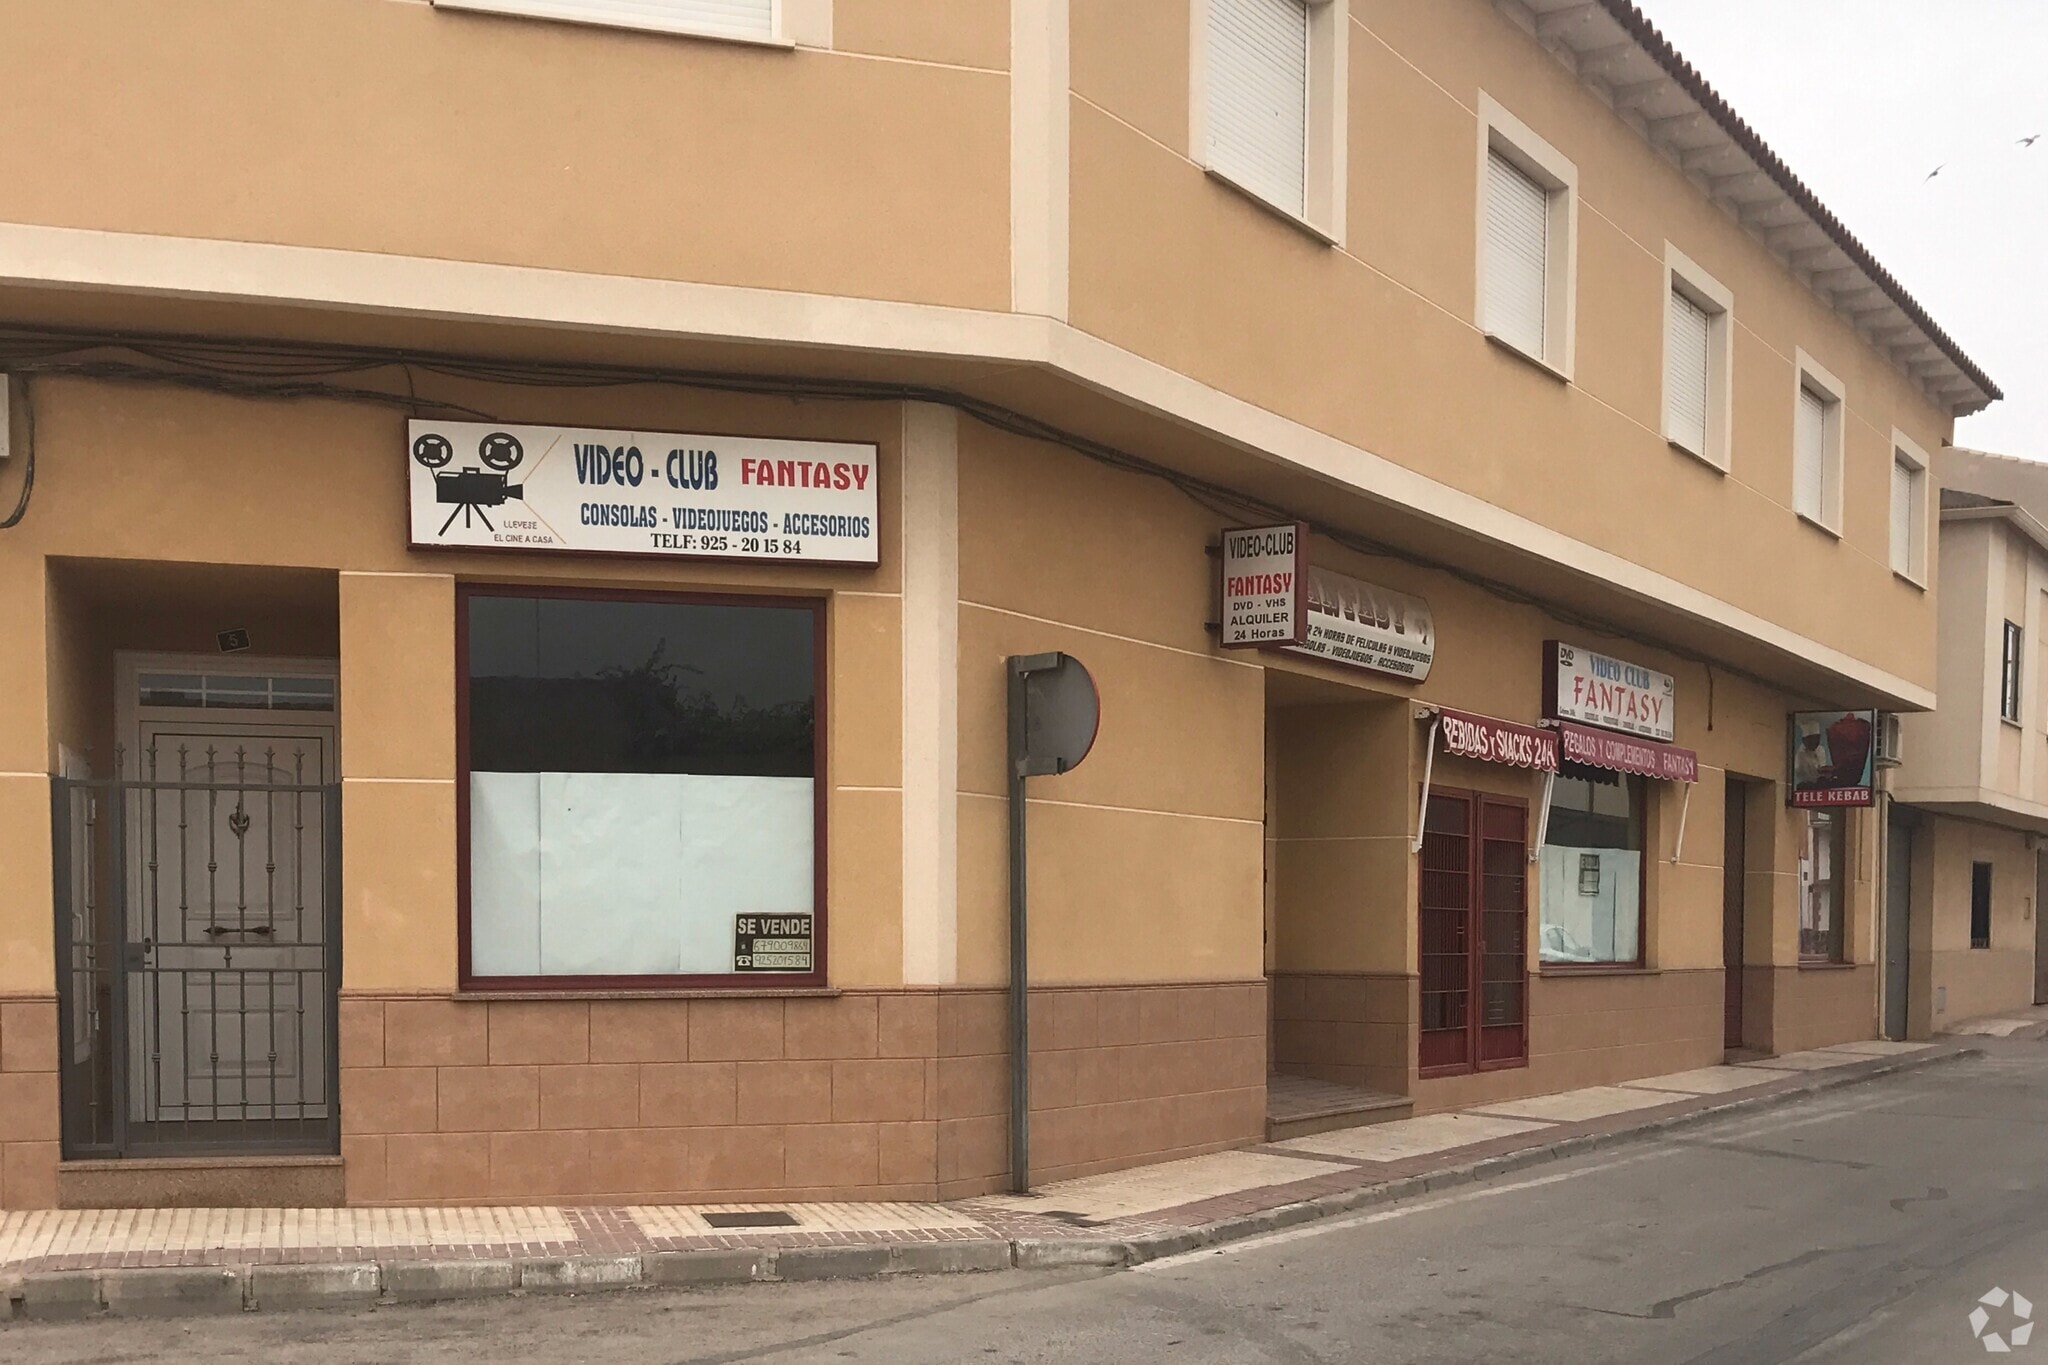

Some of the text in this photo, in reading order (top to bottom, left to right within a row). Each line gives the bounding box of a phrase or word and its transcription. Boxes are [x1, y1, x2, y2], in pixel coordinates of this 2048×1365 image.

[573, 443, 644, 487] VIDEO
[666, 449, 718, 490] CLUB
[741, 458, 869, 490] FANTASY
[580, 502, 657, 528] CONSOLAS
[672, 507, 768, 533] VIDEOJUEGOS
[783, 513, 870, 538] ACCESORIOS
[494, 534, 553, 544] EL CINE A CASA
[650, 533, 697, 550] TELF:
[700, 536, 728, 551] 925
[741, 537, 759, 553] 20
[764, 539, 779, 553] 15
[783, 540, 801, 554] 84
[1229, 532, 1294, 559] VIDEO-CLUB
[1228, 573, 1292, 597] FANTASY
[1233, 601, 1253, 611] DVD
[1266, 598, 1286, 608] VHS
[1230, 612, 1289, 626] ALQUILER
[1234, 629, 1285, 640] 24 Horas
[1313, 626, 1323, 638] 24
[1323, 629, 1346, 643] HORAS
[1346, 633, 1356, 645] DE
[1589, 654, 1650, 690] VIDEO CLUB
[1574, 675, 1664, 724] FANTASY
[1605, 740, 1656, 769] COMPLEMENTOS
[1663, 752, 1694, 775] FANTASY
[1795, 790, 1869, 802] TELE KEBAB
[737, 918, 810, 935] SE VENDE
